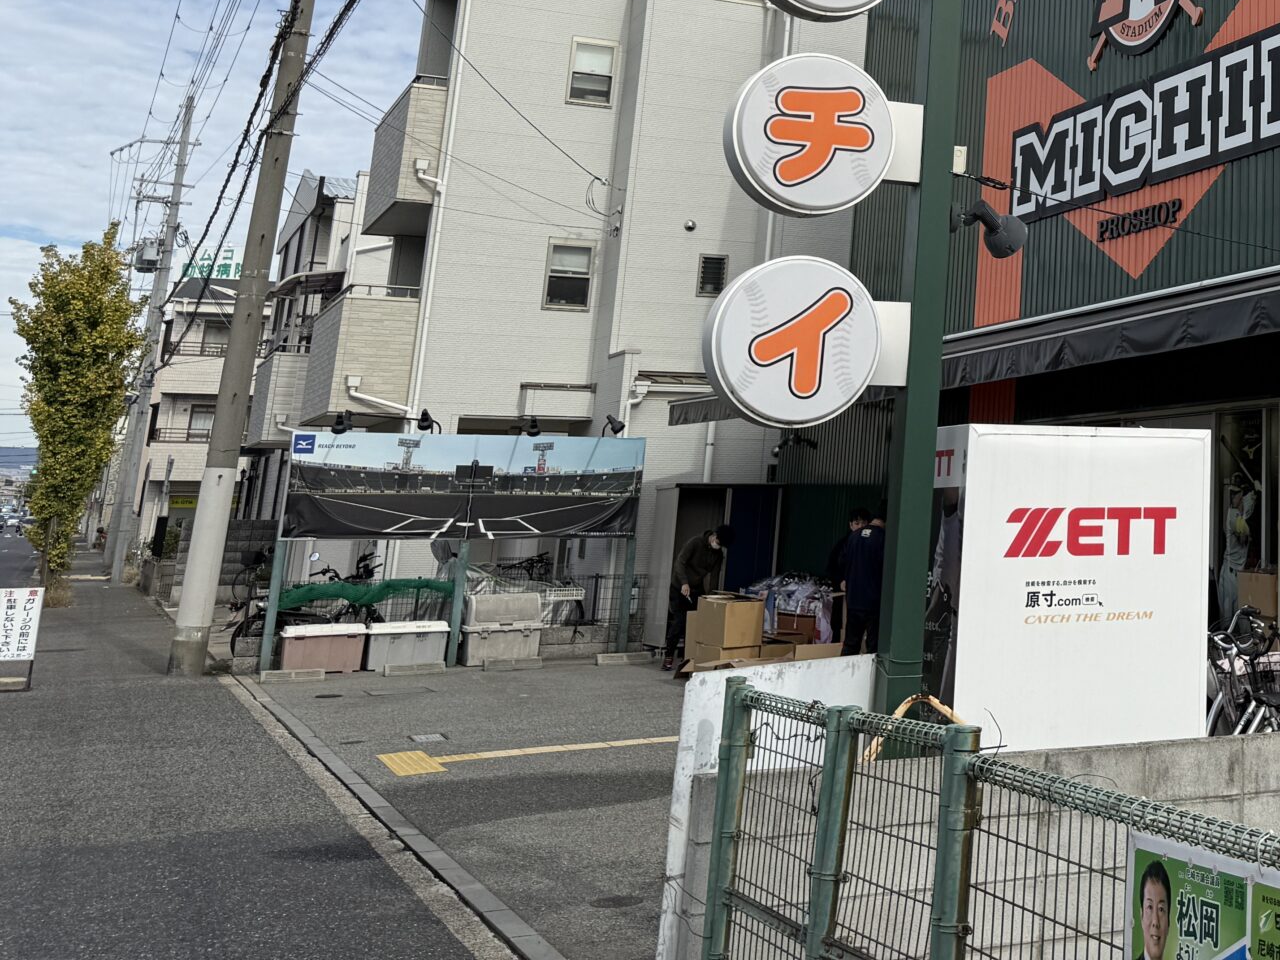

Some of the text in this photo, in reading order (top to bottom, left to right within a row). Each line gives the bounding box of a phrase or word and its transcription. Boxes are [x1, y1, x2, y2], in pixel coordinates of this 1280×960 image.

[1120, 5, 1164, 38] STADIUM
[1096, 198, 1183, 243] PROSHOP
[935, 448, 955, 477] TT
[1003, 506, 1178, 558] ZETT
[1024, 610, 1154, 625] CATCH THE DREAM
[1025, 590, 1081, 608] 原寸.com
[16, 598, 36, 652] ガレージの前には
[1176, 890, 1221, 950] 松岡
